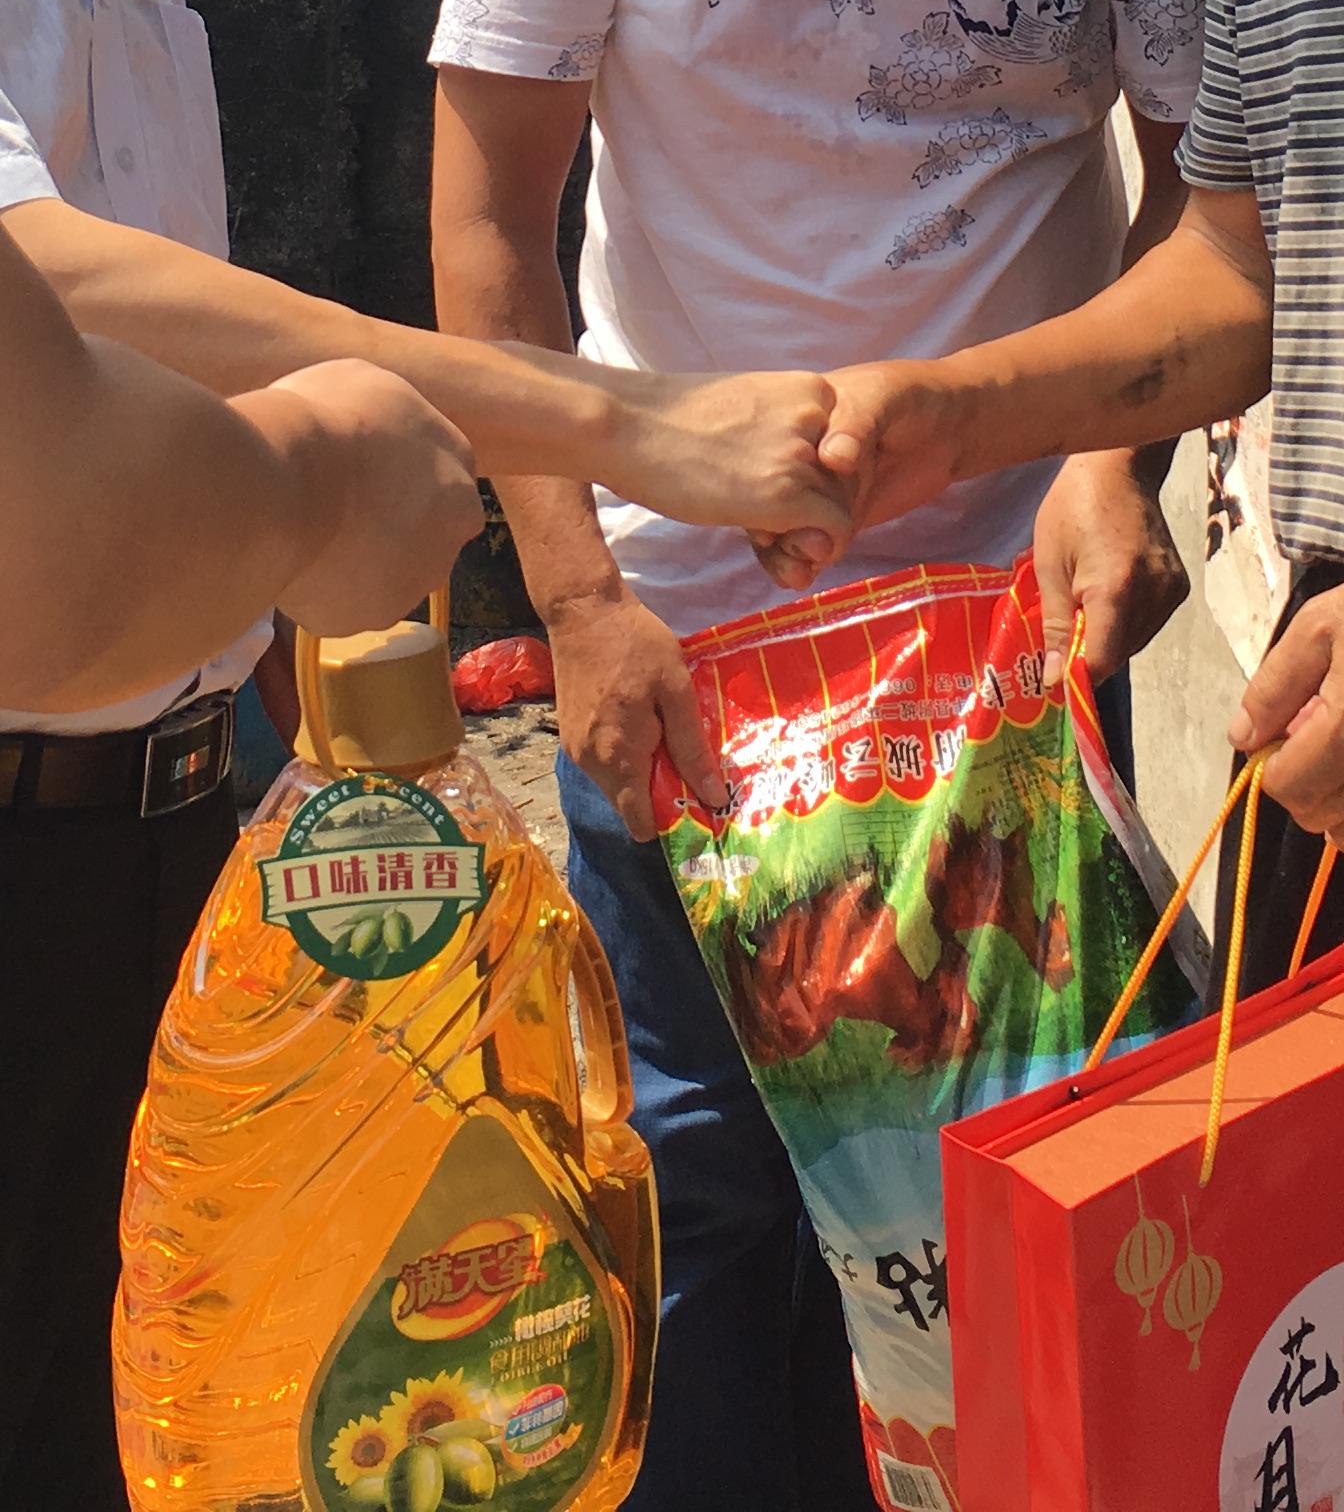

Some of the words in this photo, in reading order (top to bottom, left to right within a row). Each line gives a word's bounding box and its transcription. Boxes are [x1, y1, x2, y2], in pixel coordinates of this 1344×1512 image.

[289, 784, 351, 846] Sweet
[283, 852, 459, 903] 口味清香
[397, 1234, 536, 1320] 满天星
